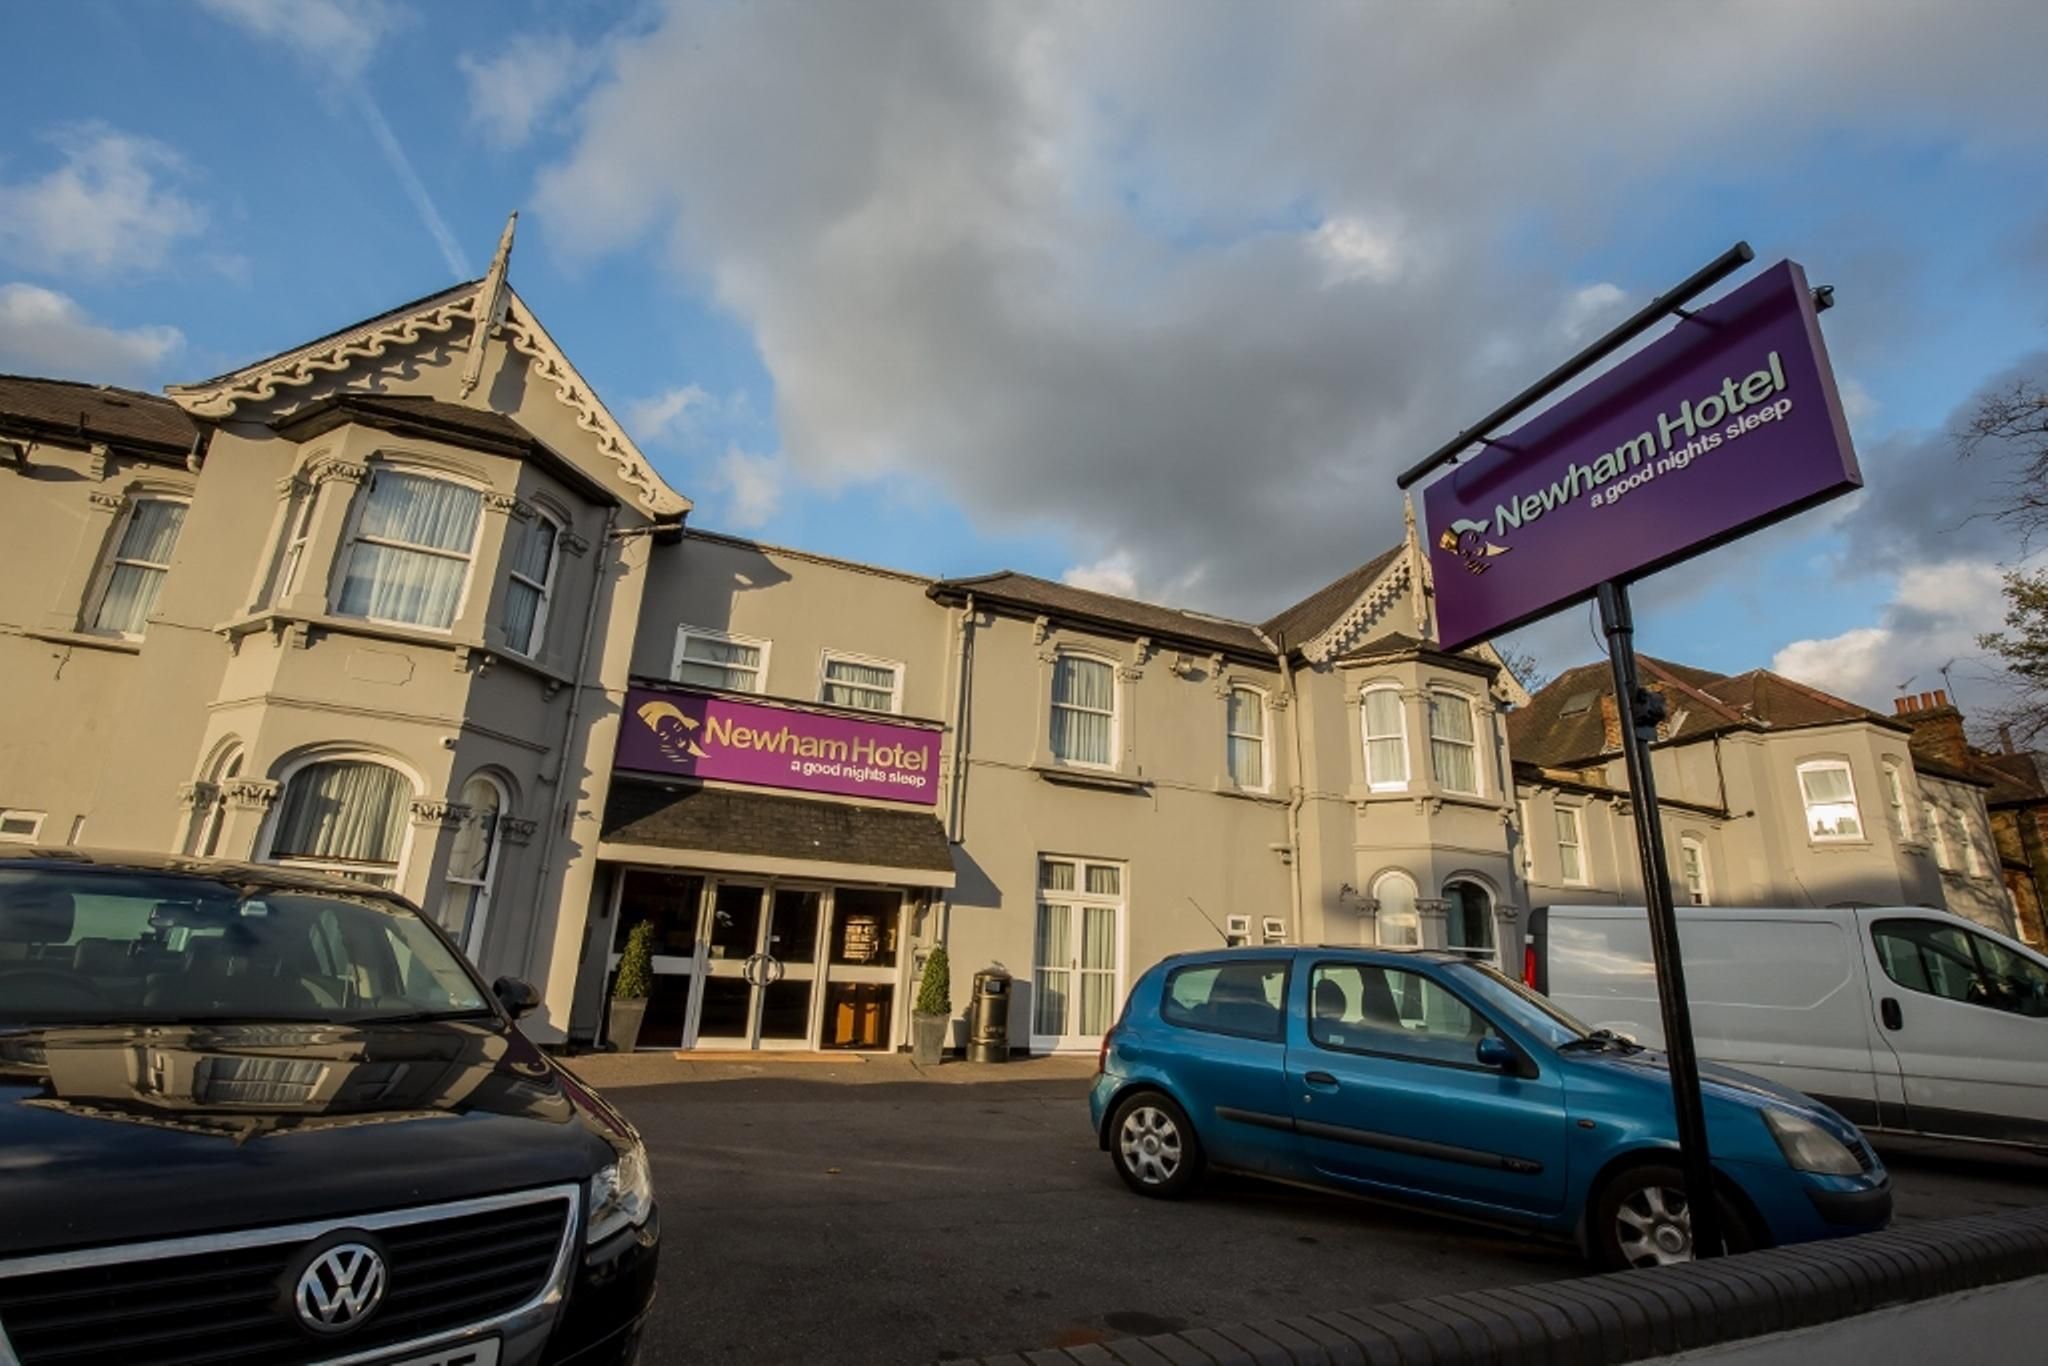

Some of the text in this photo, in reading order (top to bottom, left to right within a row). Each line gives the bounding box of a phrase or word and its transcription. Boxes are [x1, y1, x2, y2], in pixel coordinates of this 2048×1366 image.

[1494, 350, 1787, 536] Newham Hotel
[1590, 397, 1793, 508] a good nights sleep
[704, 715, 929, 772] Newham Hotel
[790, 760, 926, 788] a good nights sleep
